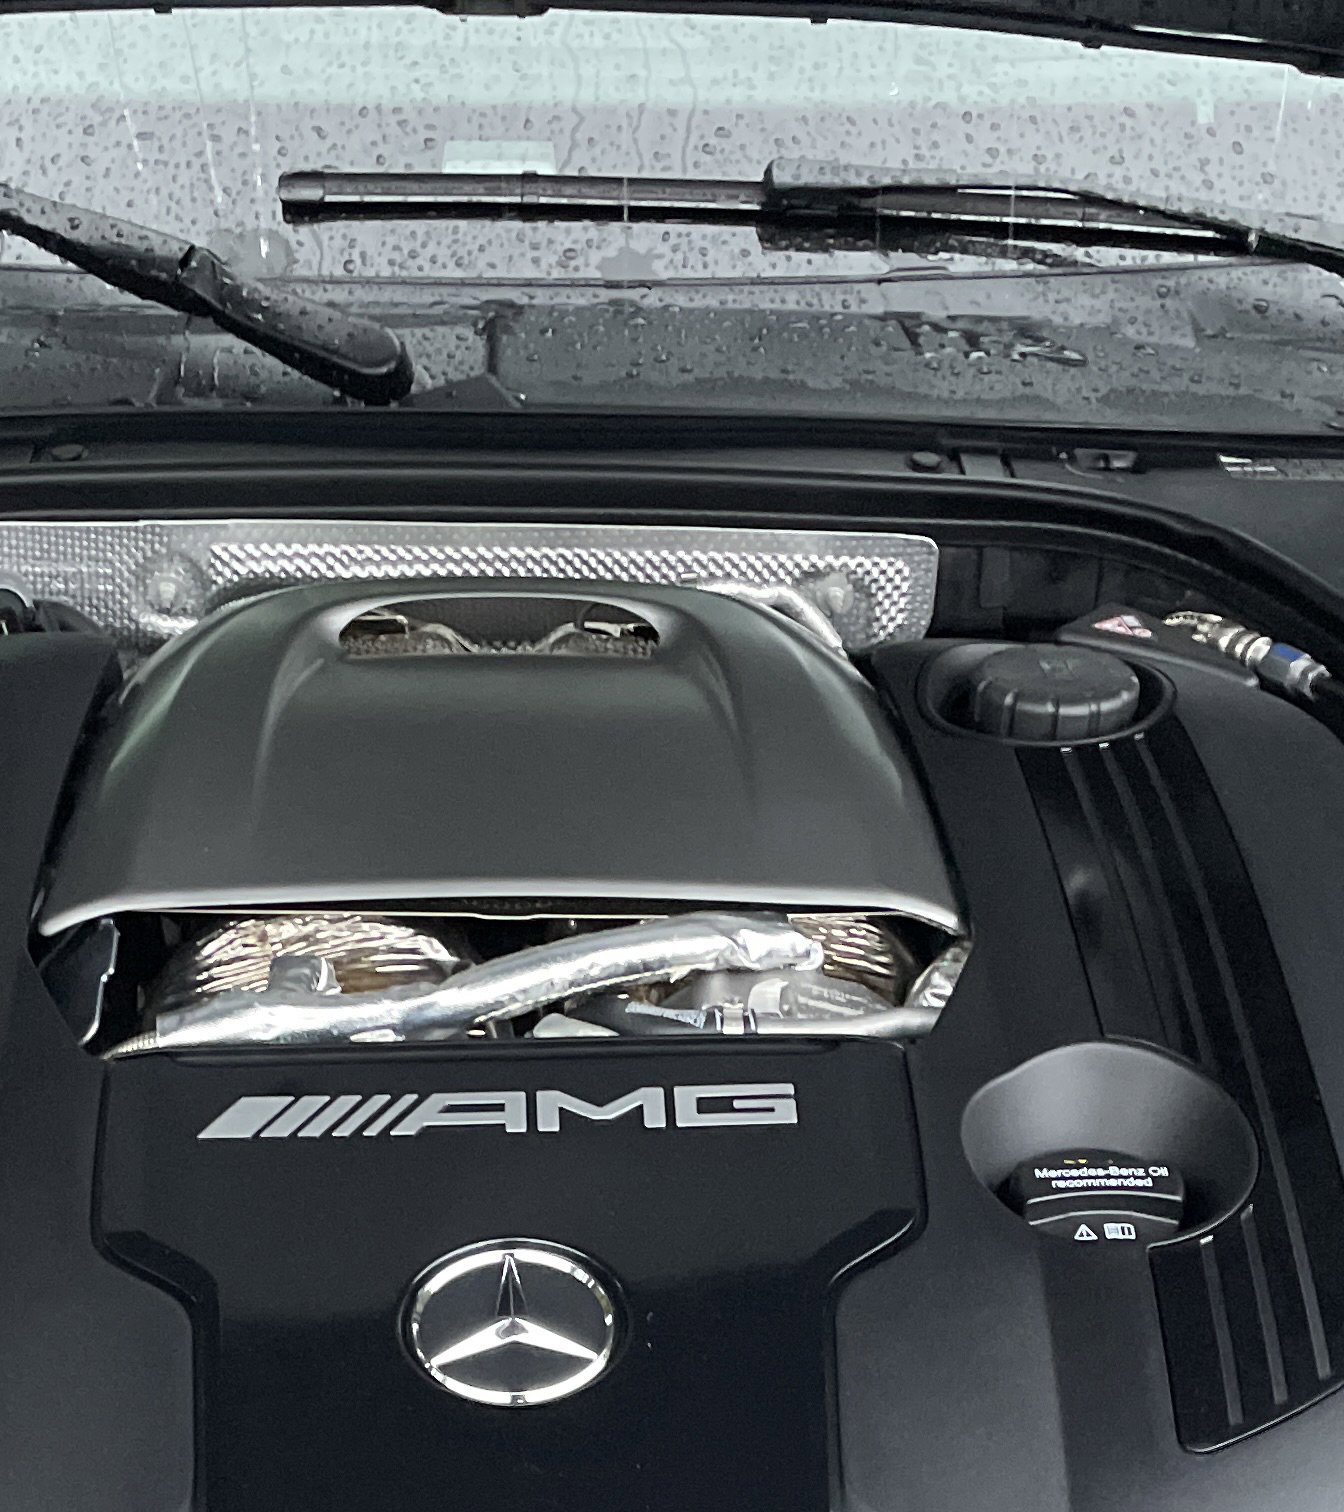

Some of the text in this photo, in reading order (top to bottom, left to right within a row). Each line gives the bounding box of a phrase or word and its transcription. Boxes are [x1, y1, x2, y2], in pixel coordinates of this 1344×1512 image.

[388, 1083, 798, 1135] AMG
[1034, 1166, 1169, 1178] Mercedes-Benz Oil
[1051, 1177, 1154, 1188] recommended
